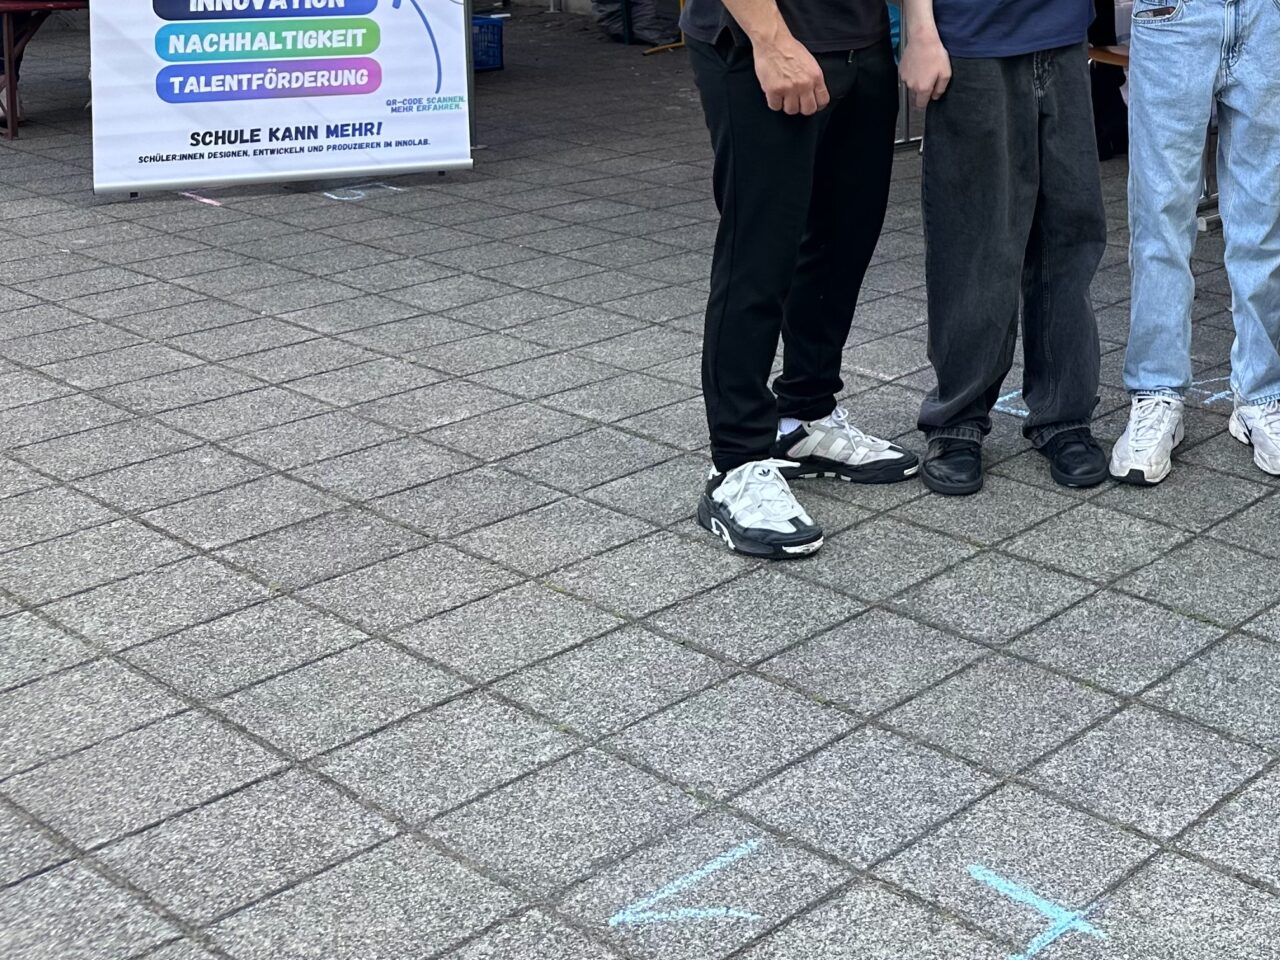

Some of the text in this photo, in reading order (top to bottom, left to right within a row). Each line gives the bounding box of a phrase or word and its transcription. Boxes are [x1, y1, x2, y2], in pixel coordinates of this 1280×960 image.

[168, 28, 367, 54] NACHHALTIGKEIT
[169, 68, 369, 94] TALENTFÖRDERUNG
[386, 97, 423, 107] QR-CODE
[390, 105, 414, 113] MEHR
[189, 122, 383, 147] SCHULE KANN MEHR!
[138, 152, 205, 164] SCHÜLER:INNEN
[253, 146, 305, 156] ENTWICKELN
[307, 145, 324, 153] UND
[326, 141, 381, 152] PRODUZIEREN
[383, 140, 393, 148] IM
